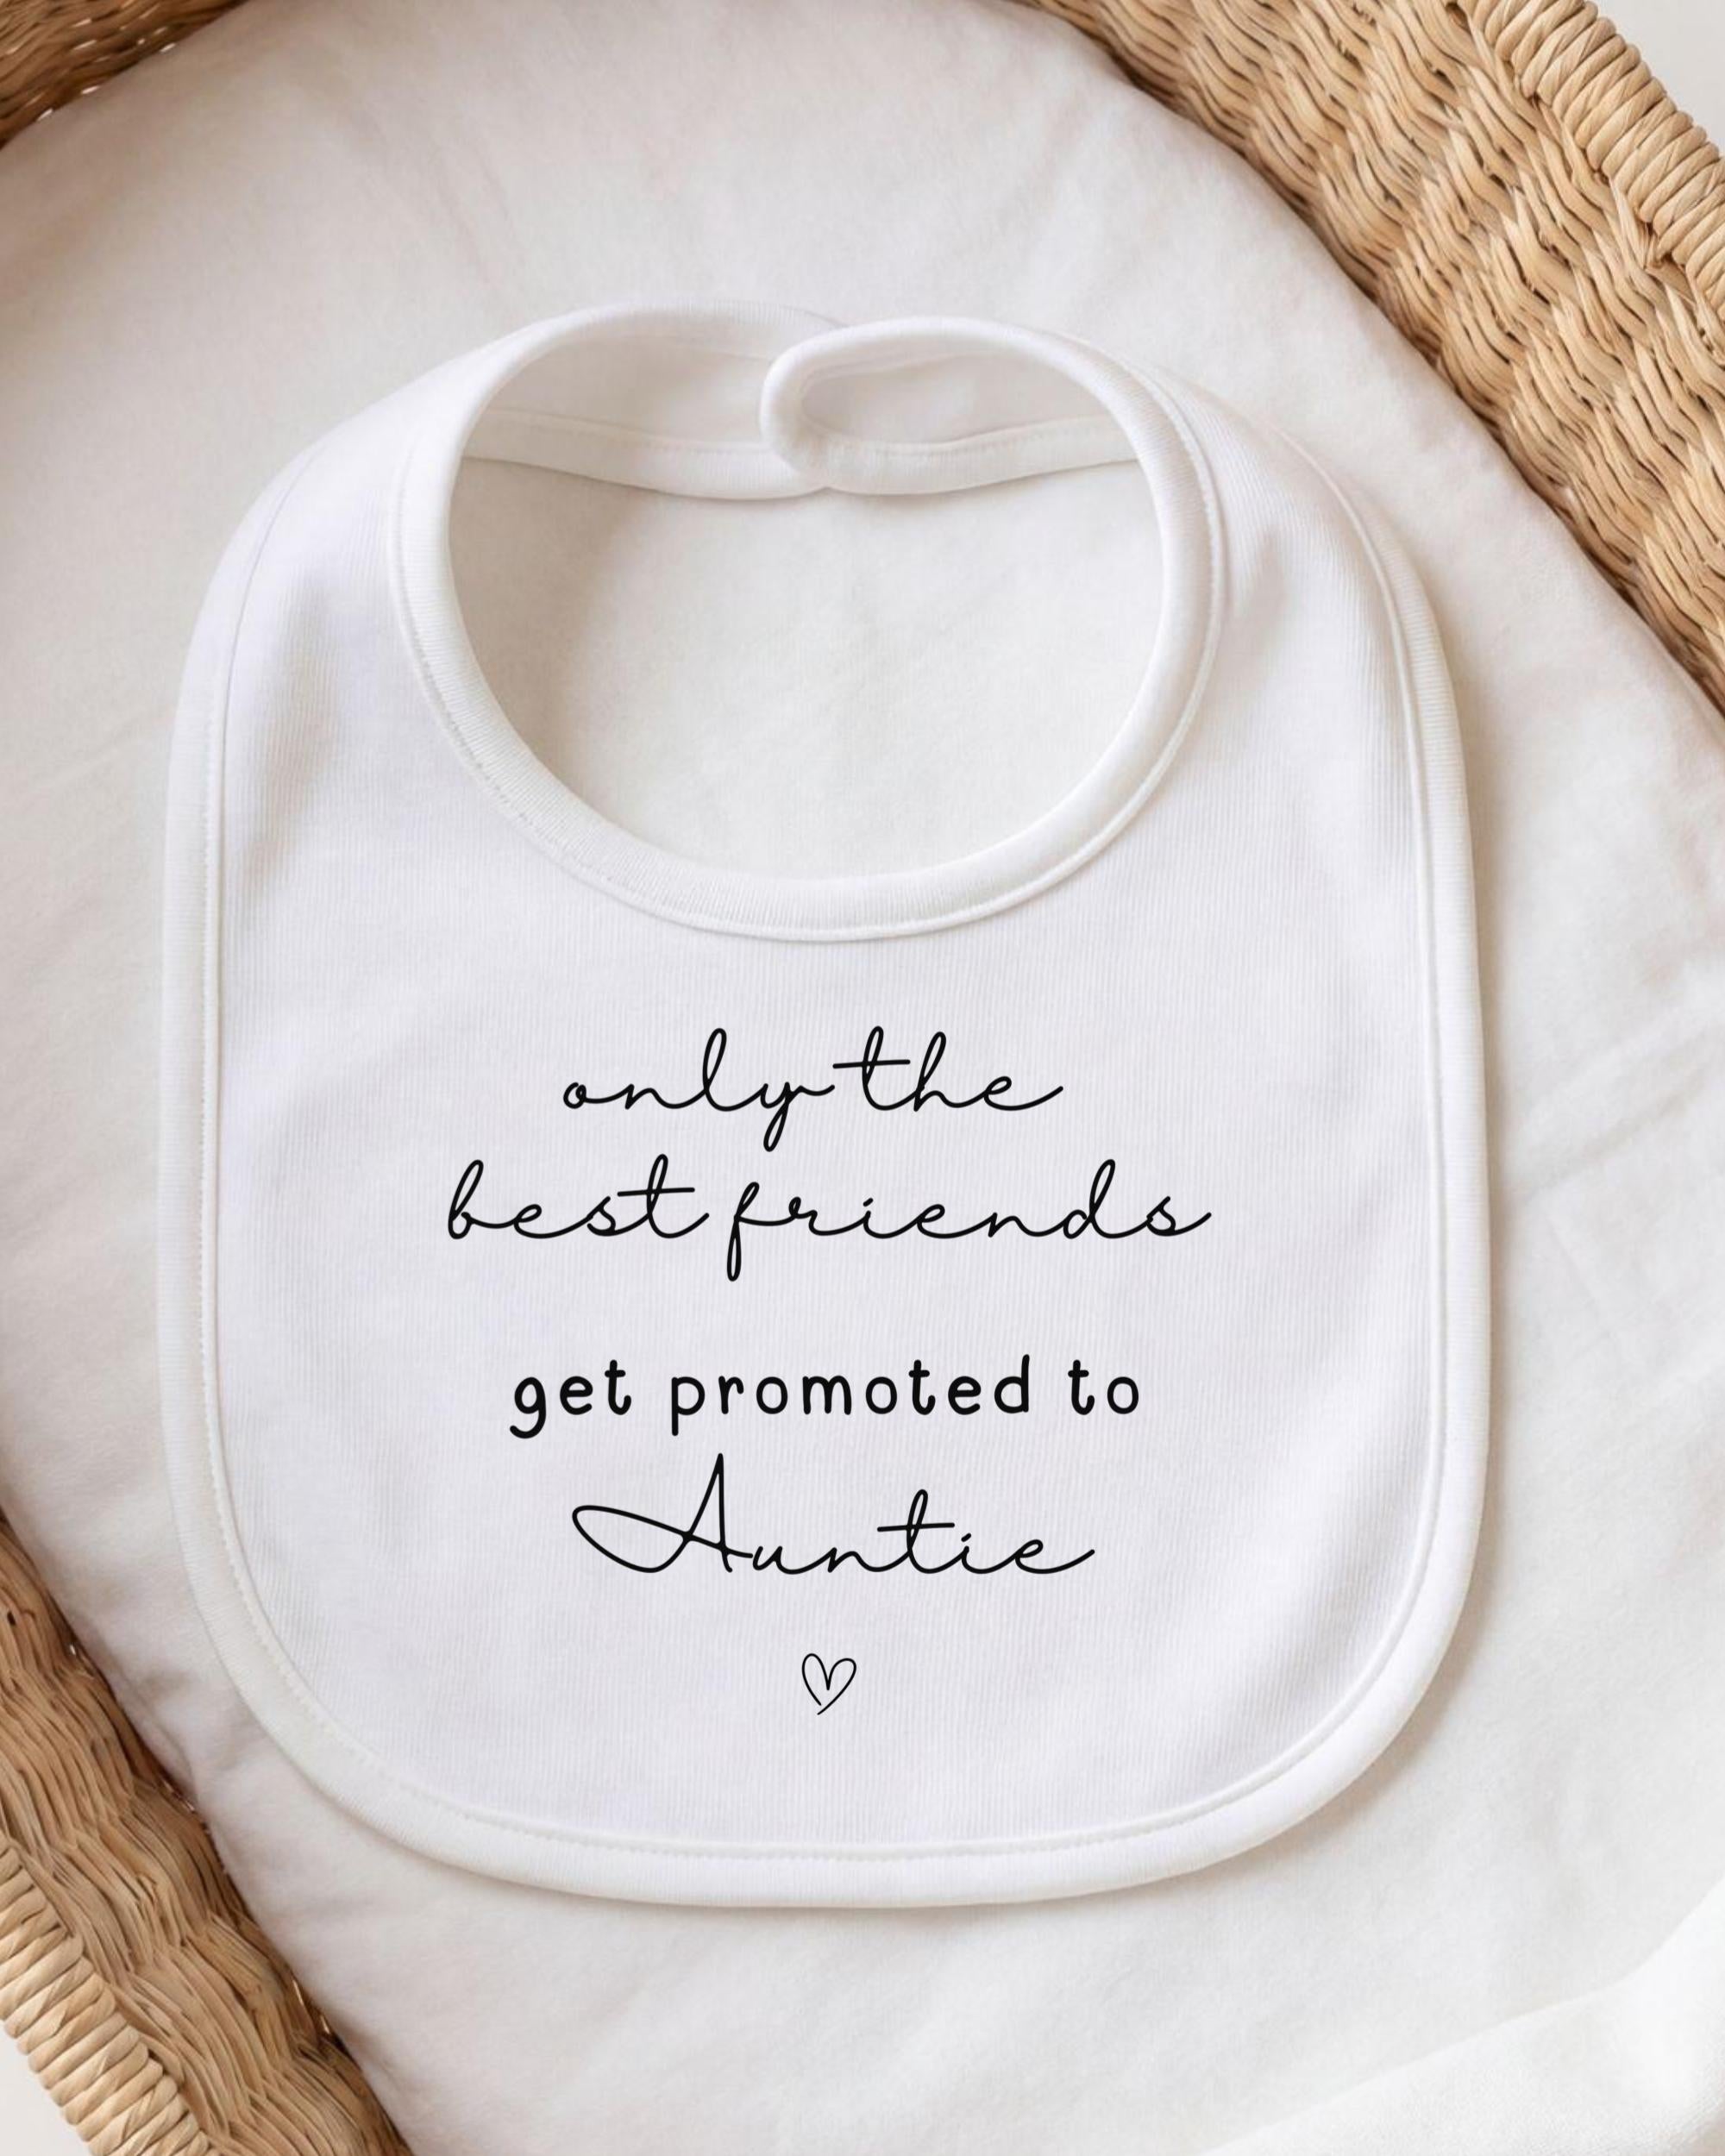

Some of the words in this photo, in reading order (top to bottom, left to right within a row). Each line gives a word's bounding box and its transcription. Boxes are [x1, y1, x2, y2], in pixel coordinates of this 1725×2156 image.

[562, 1027, 836, 1153] only
[832, 1025, 1064, 1112] the
[448, 1153, 710, 1240] best
[726, 1158, 1212, 1282] friends
[509, 1359, 632, 1439] get
[671, 1354, 1031, 1437] promoted
[1067, 1359, 1139, 1416] to
[571, 1452, 1095, 1576] Auntie
